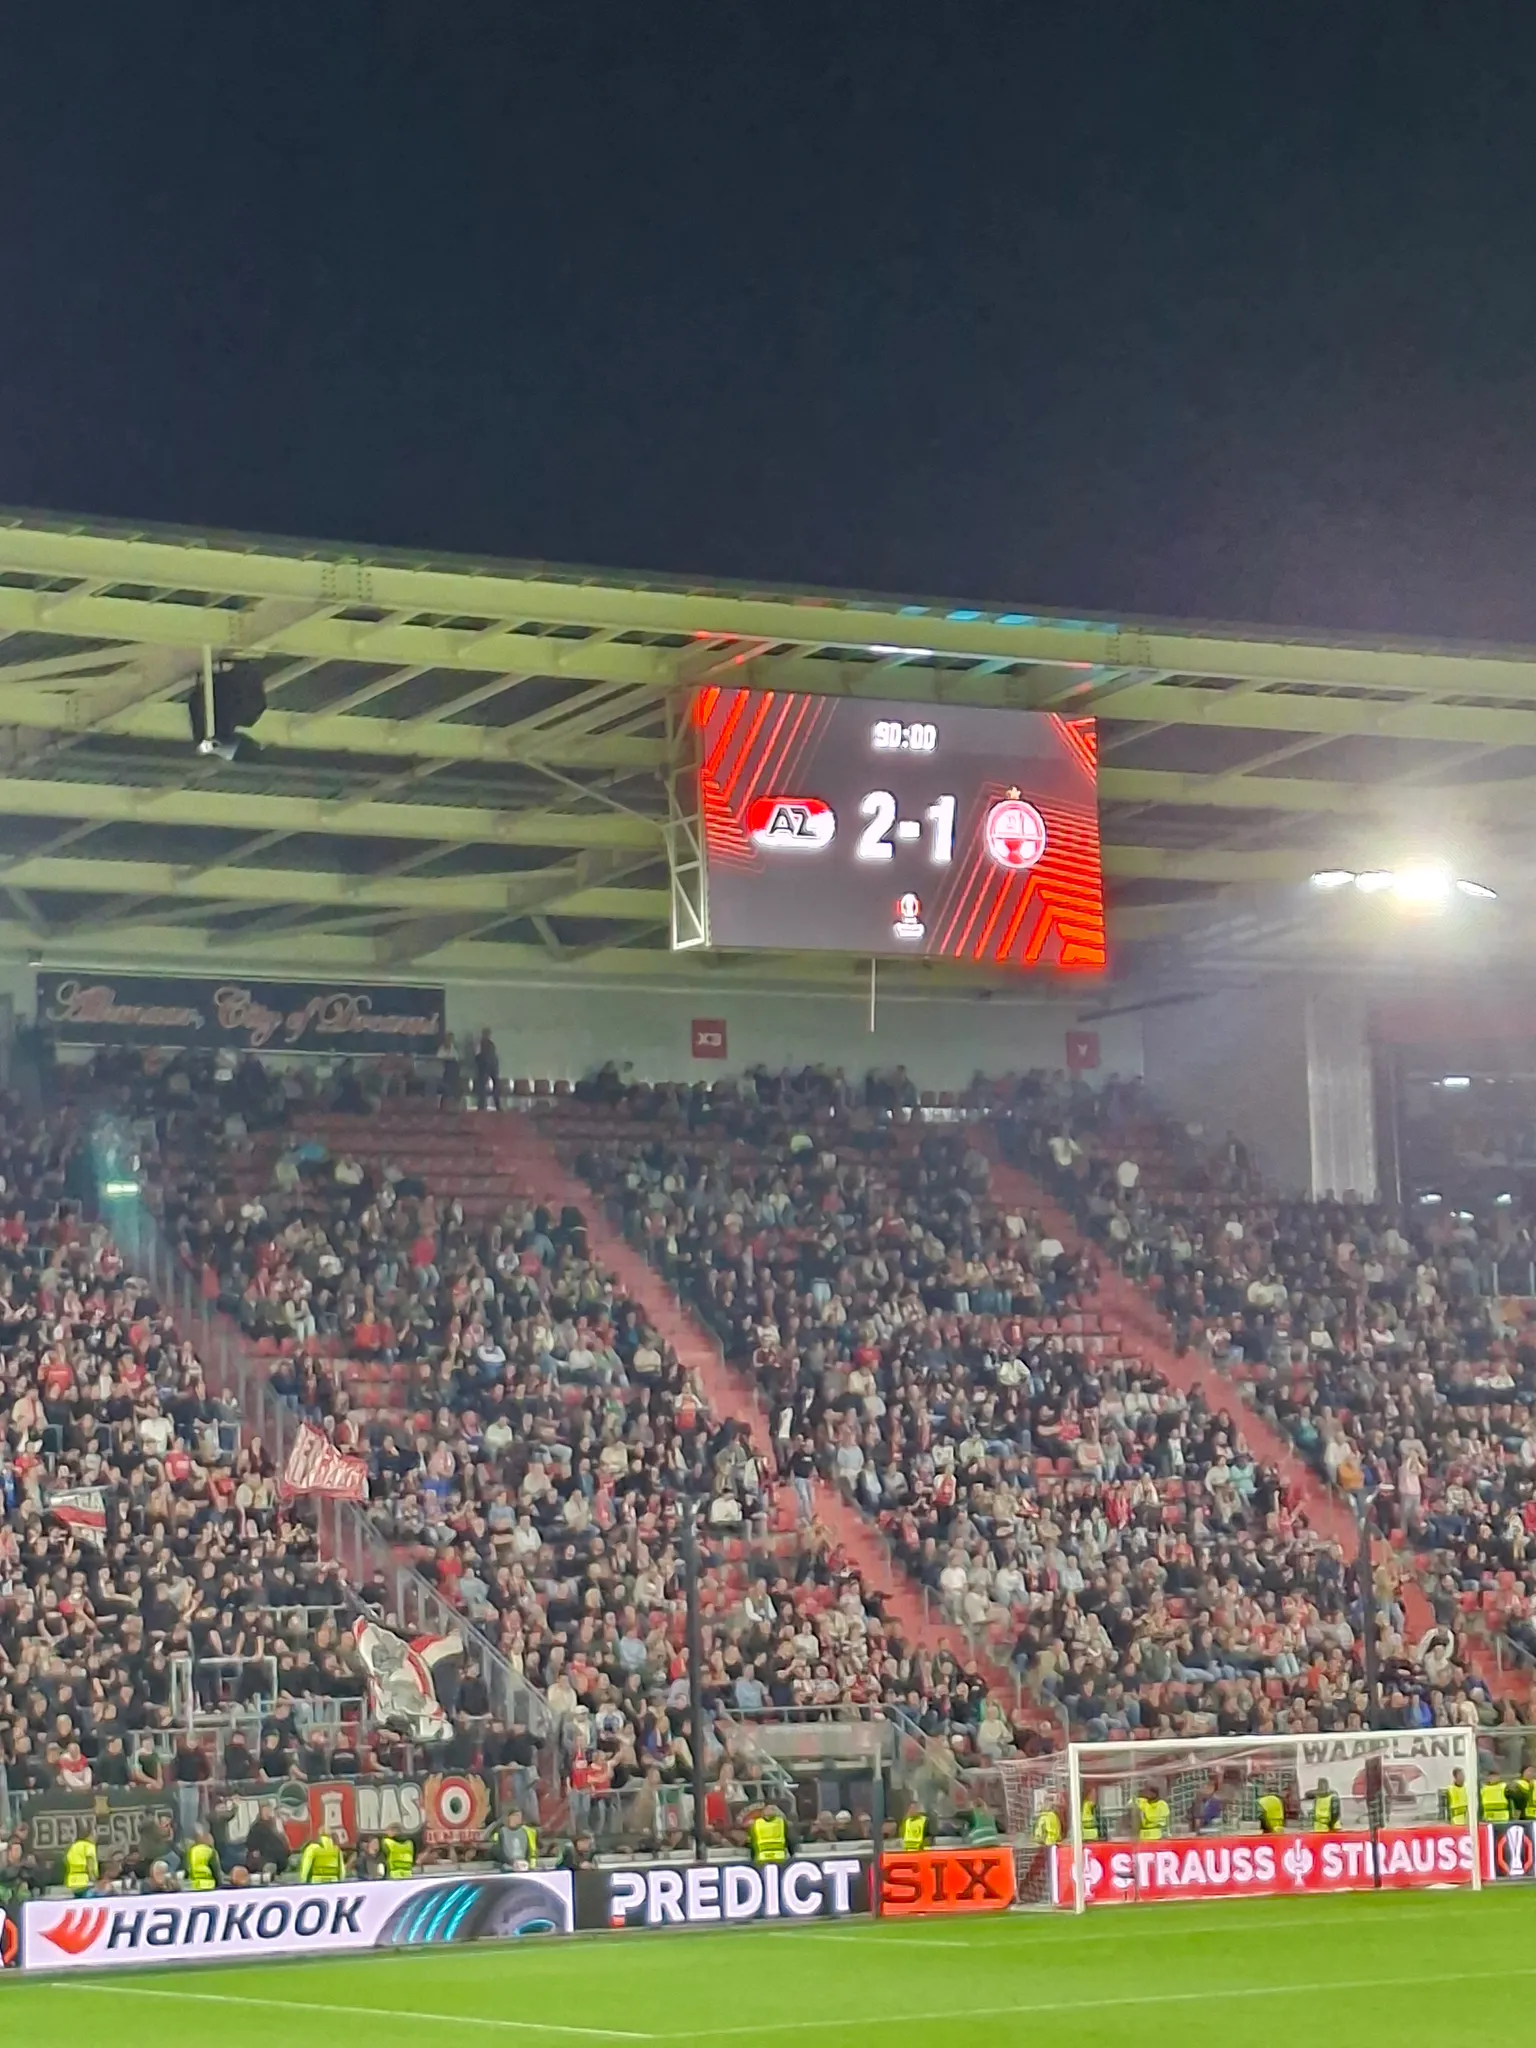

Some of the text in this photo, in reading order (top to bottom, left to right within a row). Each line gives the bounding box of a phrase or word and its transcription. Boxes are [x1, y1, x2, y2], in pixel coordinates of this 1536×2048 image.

[873, 720, 938, 750] 90:00
[766, 806, 820, 837] AZ
[1110, 1835, 1474, 1889] STRAUSS STRAUSS
[611, 1858, 1002, 1929] PREDICT SIX
